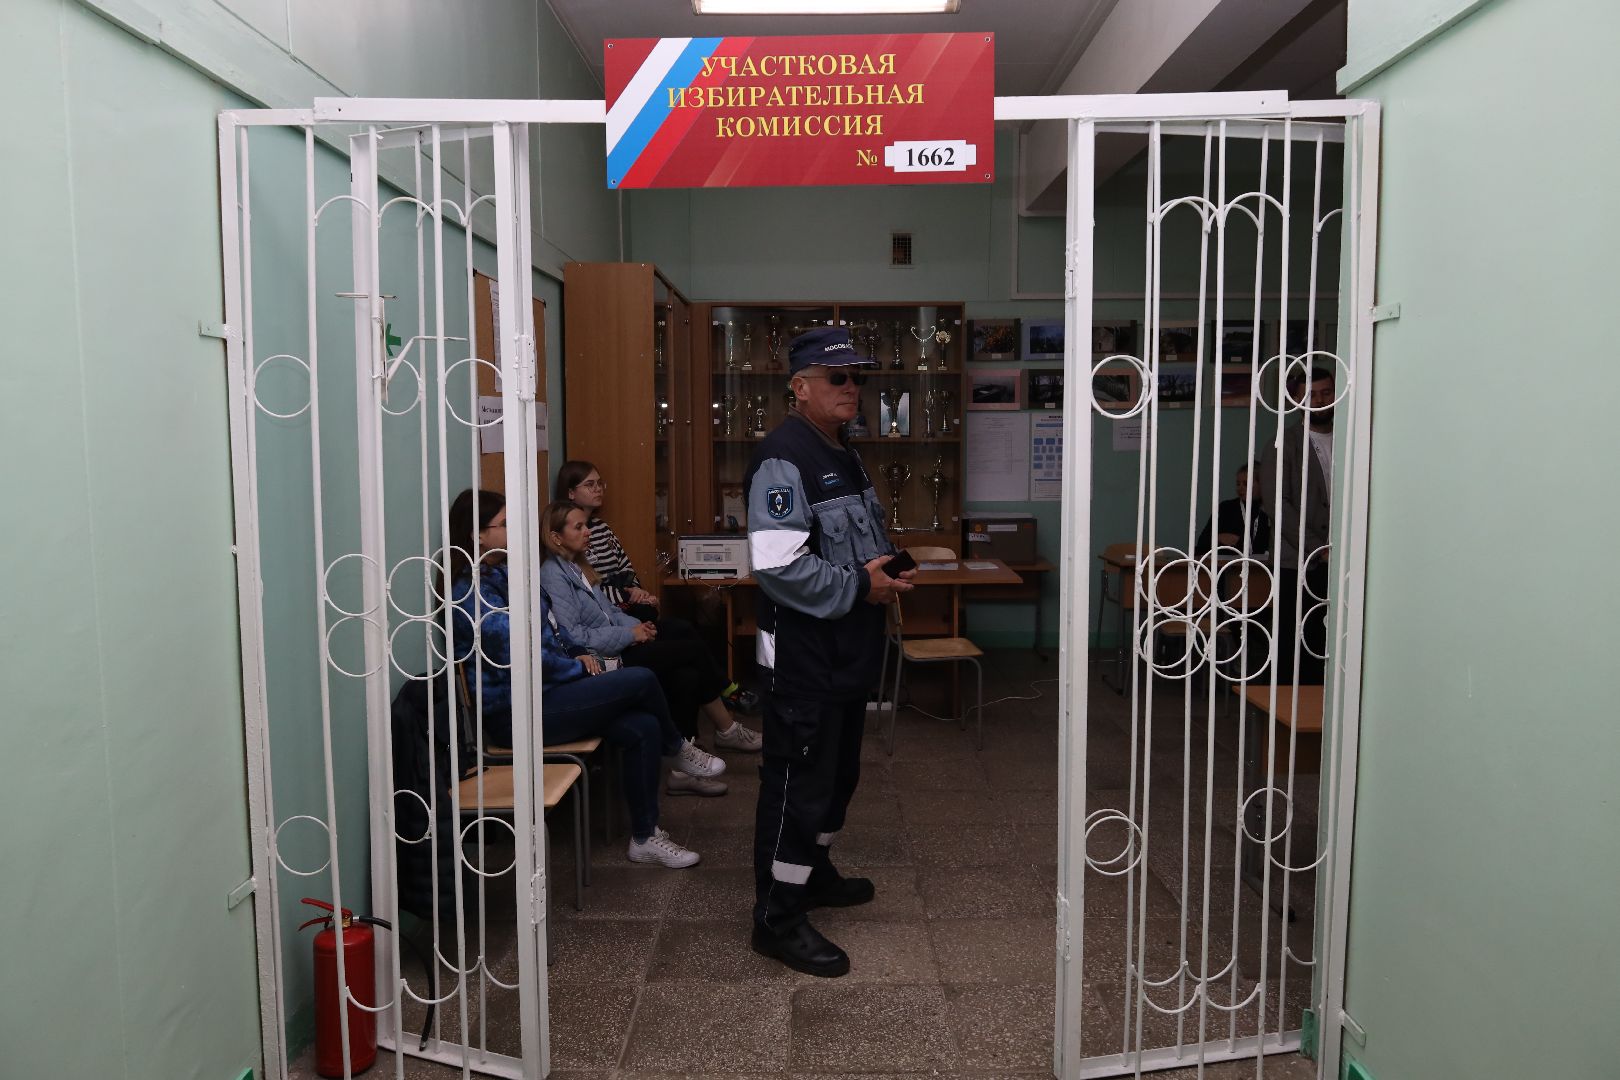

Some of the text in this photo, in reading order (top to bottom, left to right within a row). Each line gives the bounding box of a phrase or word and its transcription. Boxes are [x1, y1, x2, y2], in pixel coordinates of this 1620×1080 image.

[701, 53, 896, 77] УЧАСТКОВАЯ
[667, 83, 925, 108] ИЗБИРАТЕЛЬНАЯ
[716, 114, 883, 138] КОМИССИЯ
[856, 147, 955, 167] № 1662
